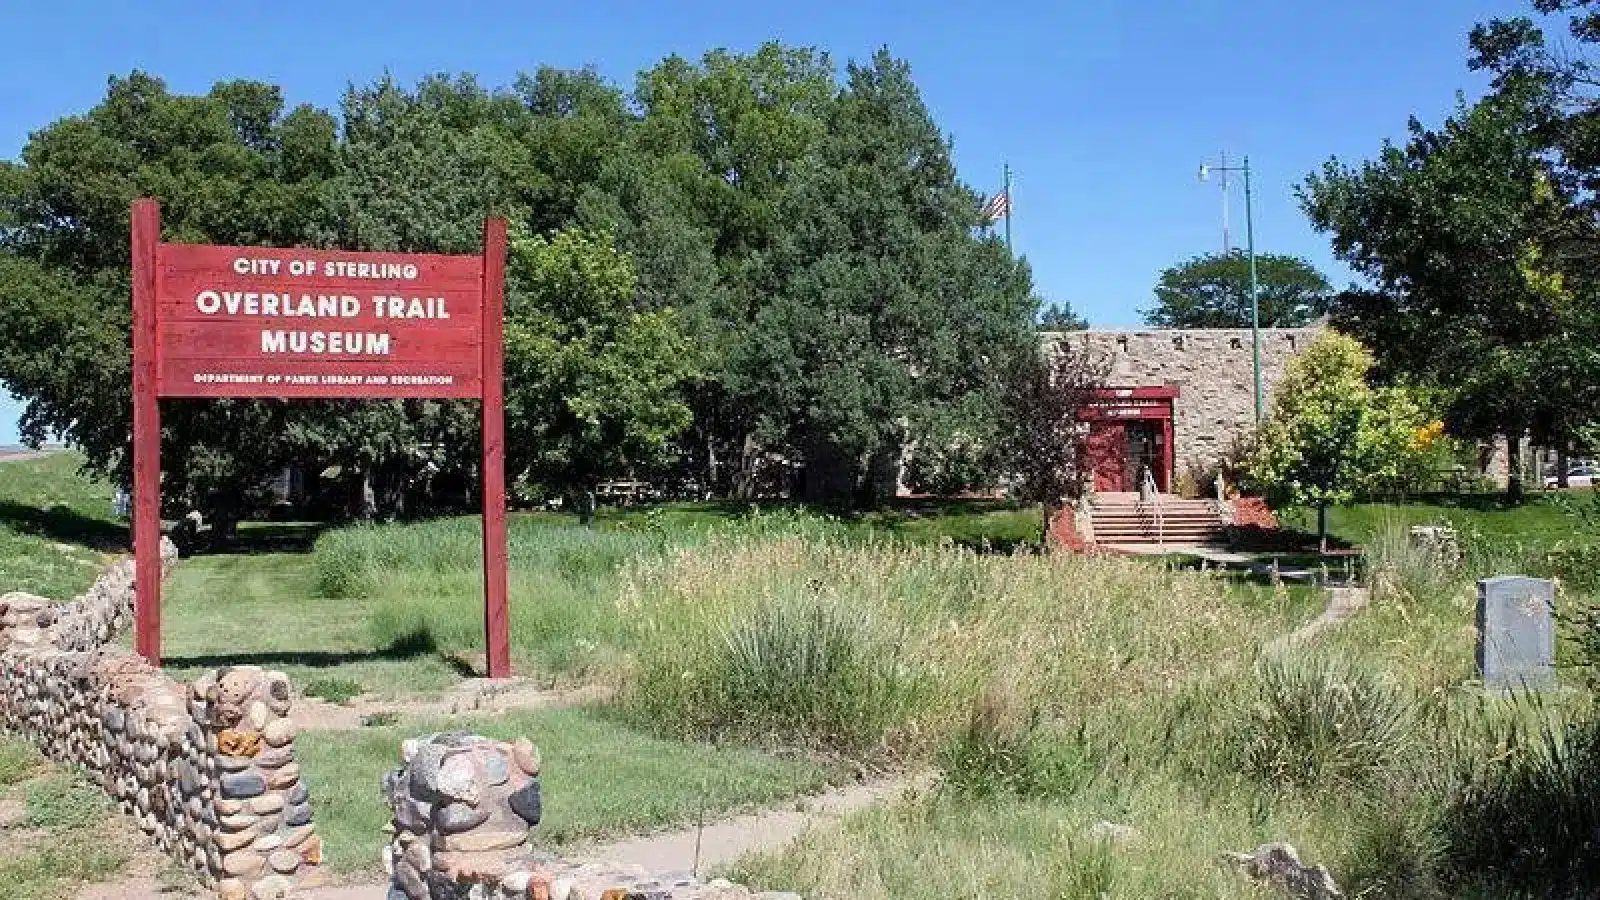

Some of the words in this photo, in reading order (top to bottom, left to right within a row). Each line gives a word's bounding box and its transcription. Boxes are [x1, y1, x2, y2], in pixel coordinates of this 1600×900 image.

[234, 258, 280, 275] CITY
[289, 260, 316, 277] OF
[325, 261, 417, 279] STERLING
[195, 291, 361, 318] OVERLAND
[372, 295, 450, 319] TRAIL
[261, 330, 390, 355] MUSEUM
[267, 374, 281, 384] OF
[365, 375, 388, 385] AND
